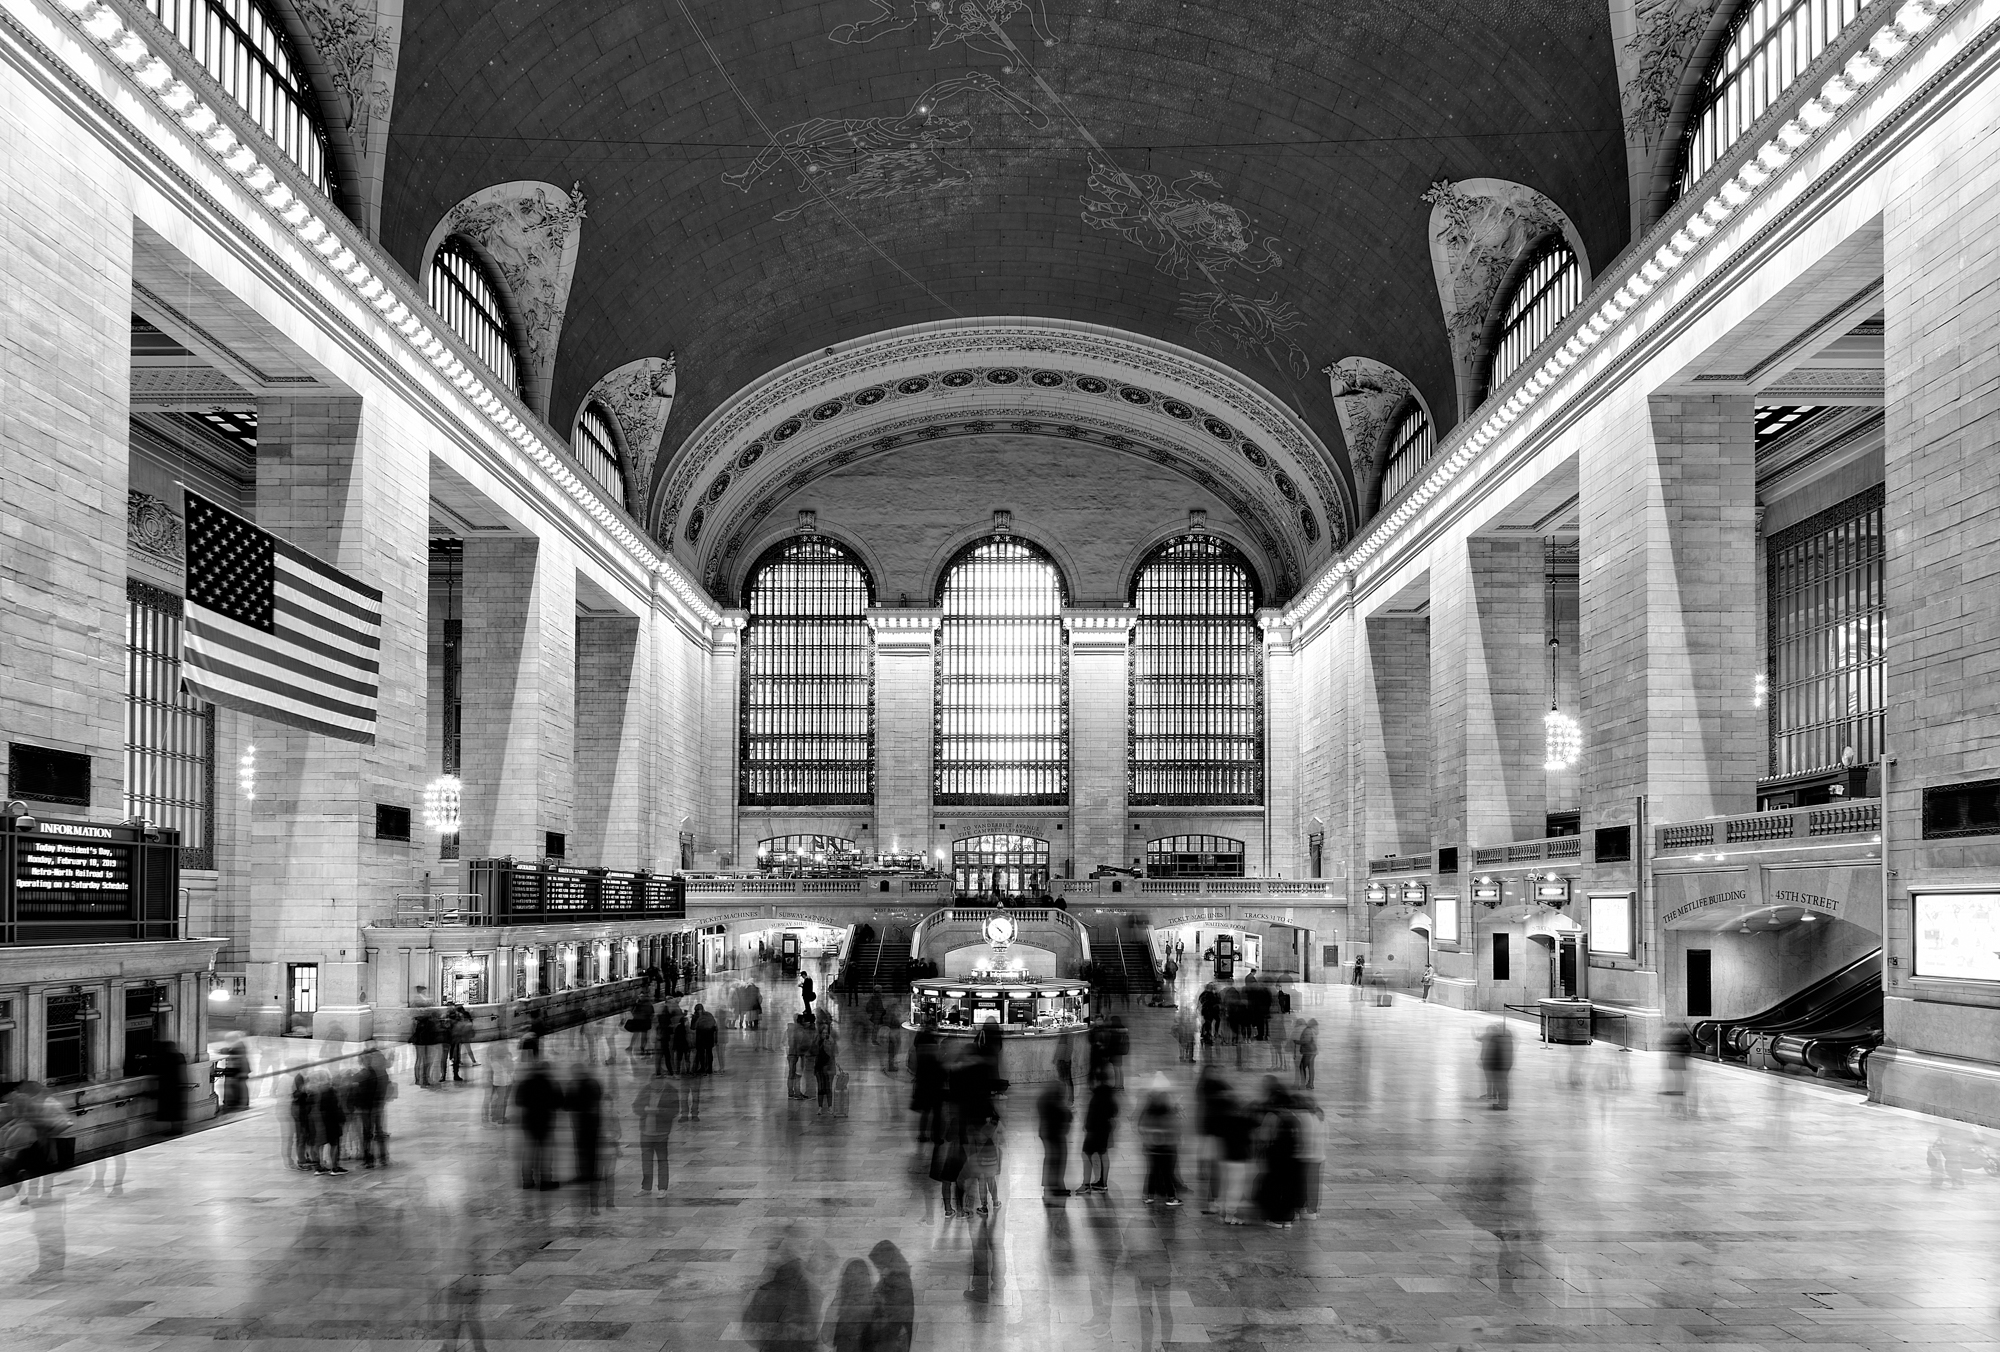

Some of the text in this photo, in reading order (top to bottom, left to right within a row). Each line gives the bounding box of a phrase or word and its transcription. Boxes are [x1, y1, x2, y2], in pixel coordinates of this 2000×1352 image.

[40, 822, 112, 839] INFORMATION
[1009, 828, 1044, 838] APARTMENT
[35, 843, 113, 857] Today President's Day,
[27, 855, 117, 868] Monday, February 18, 2019
[31, 867, 114, 879] Metro-North Railroad is
[16, 879, 51, 889] Operating
[71, 880, 100, 890] Saturday
[102, 881, 129, 890] Schedule
[1662, 889, 1747, 925] THE METLIFE BUILDING
[1775, 890, 1840, 911] 45TH STREET
[699, 911, 758, 924] TICKET MACHINES
[778, 911, 805, 919] SUBWAY
[1191, 912, 1224, 920] MACHINES
